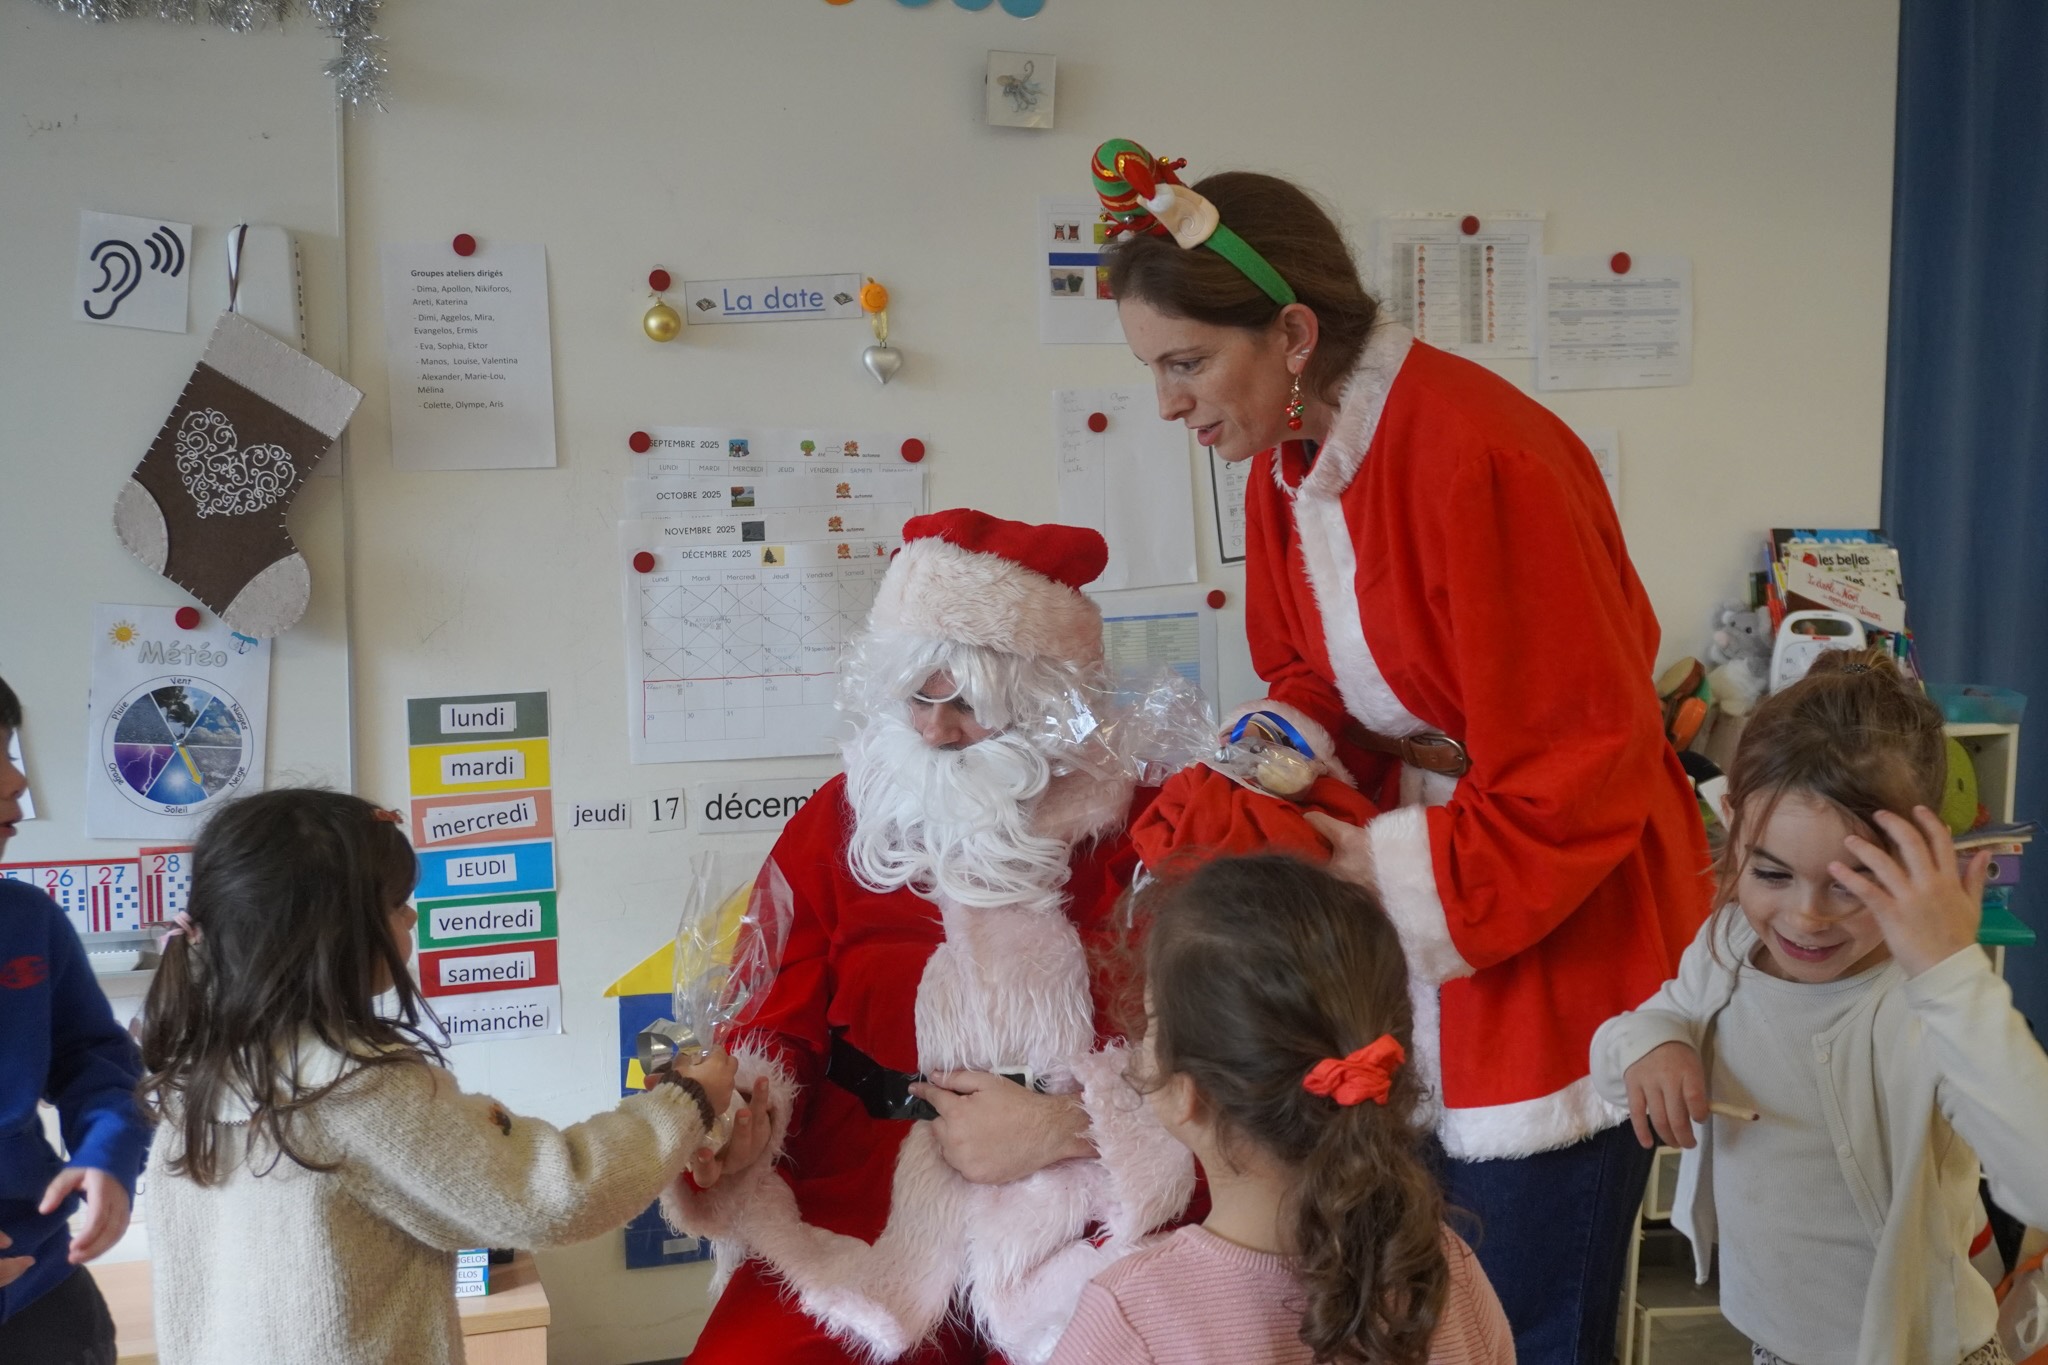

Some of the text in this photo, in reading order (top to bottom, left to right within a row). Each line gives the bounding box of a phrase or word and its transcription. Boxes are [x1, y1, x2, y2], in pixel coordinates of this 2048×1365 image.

[411, 269, 503, 278] Groupes ateliers dirigés
[417, 285, 512, 294] Dima, Apollon, Nikiforos,
[412, 298, 468, 307] Areti, Katerina
[724, 286, 824, 311] La date
[418, 314, 495, 322] Dimi, Aggelos, Mira,
[414, 327, 455, 336] Evangelos,
[420, 342, 488, 350] Eva, Sophia, Ektor
[421, 357, 518, 366] Manos, Louise, Valentina
[422, 373, 506, 382] Alexander, Marie-Lou,
[418, 386, 444, 394] Mélina
[423, 400, 504, 410] Colette, Olympe, Aris
[650, 440, 720, 449] SEPTEMBRE 2025
[659, 464, 679, 472] LUNDI
[698, 464, 720, 472] MARDI
[732, 465, 764, 473] MERCREDI
[656, 490, 722, 500] OCTOBRE 2025
[664, 525, 736, 536] NOVEMBRE 2025
[682, 549, 752, 560] DÉCEMBRE 2025
[1819, 553, 1870, 566] les belles
[138, 640, 228, 668] Météo
[170, 676, 192, 685] Vent
[112, 700, 130, 721] Pluie
[230, 703, 248, 730] Nuages
[452, 707, 504, 727] lundi
[452, 756, 514, 776] mardi
[109, 762, 125, 786] Orage
[229, 766, 246, 788] Neige
[164, 805, 188, 814] Soleil
[574, 789, 817, 827] jeudi 17 décem
[432, 803, 528, 838] mercredi
[46, 868, 74, 888] 26
[99, 866, 126, 885] 27
[153, 854, 180, 874] 28
[457, 860, 506, 878] JEUDI
[439, 909, 534, 932] vendredi
[448, 960, 524, 983] samedi
[441, 1010, 544, 1034] dimanche
